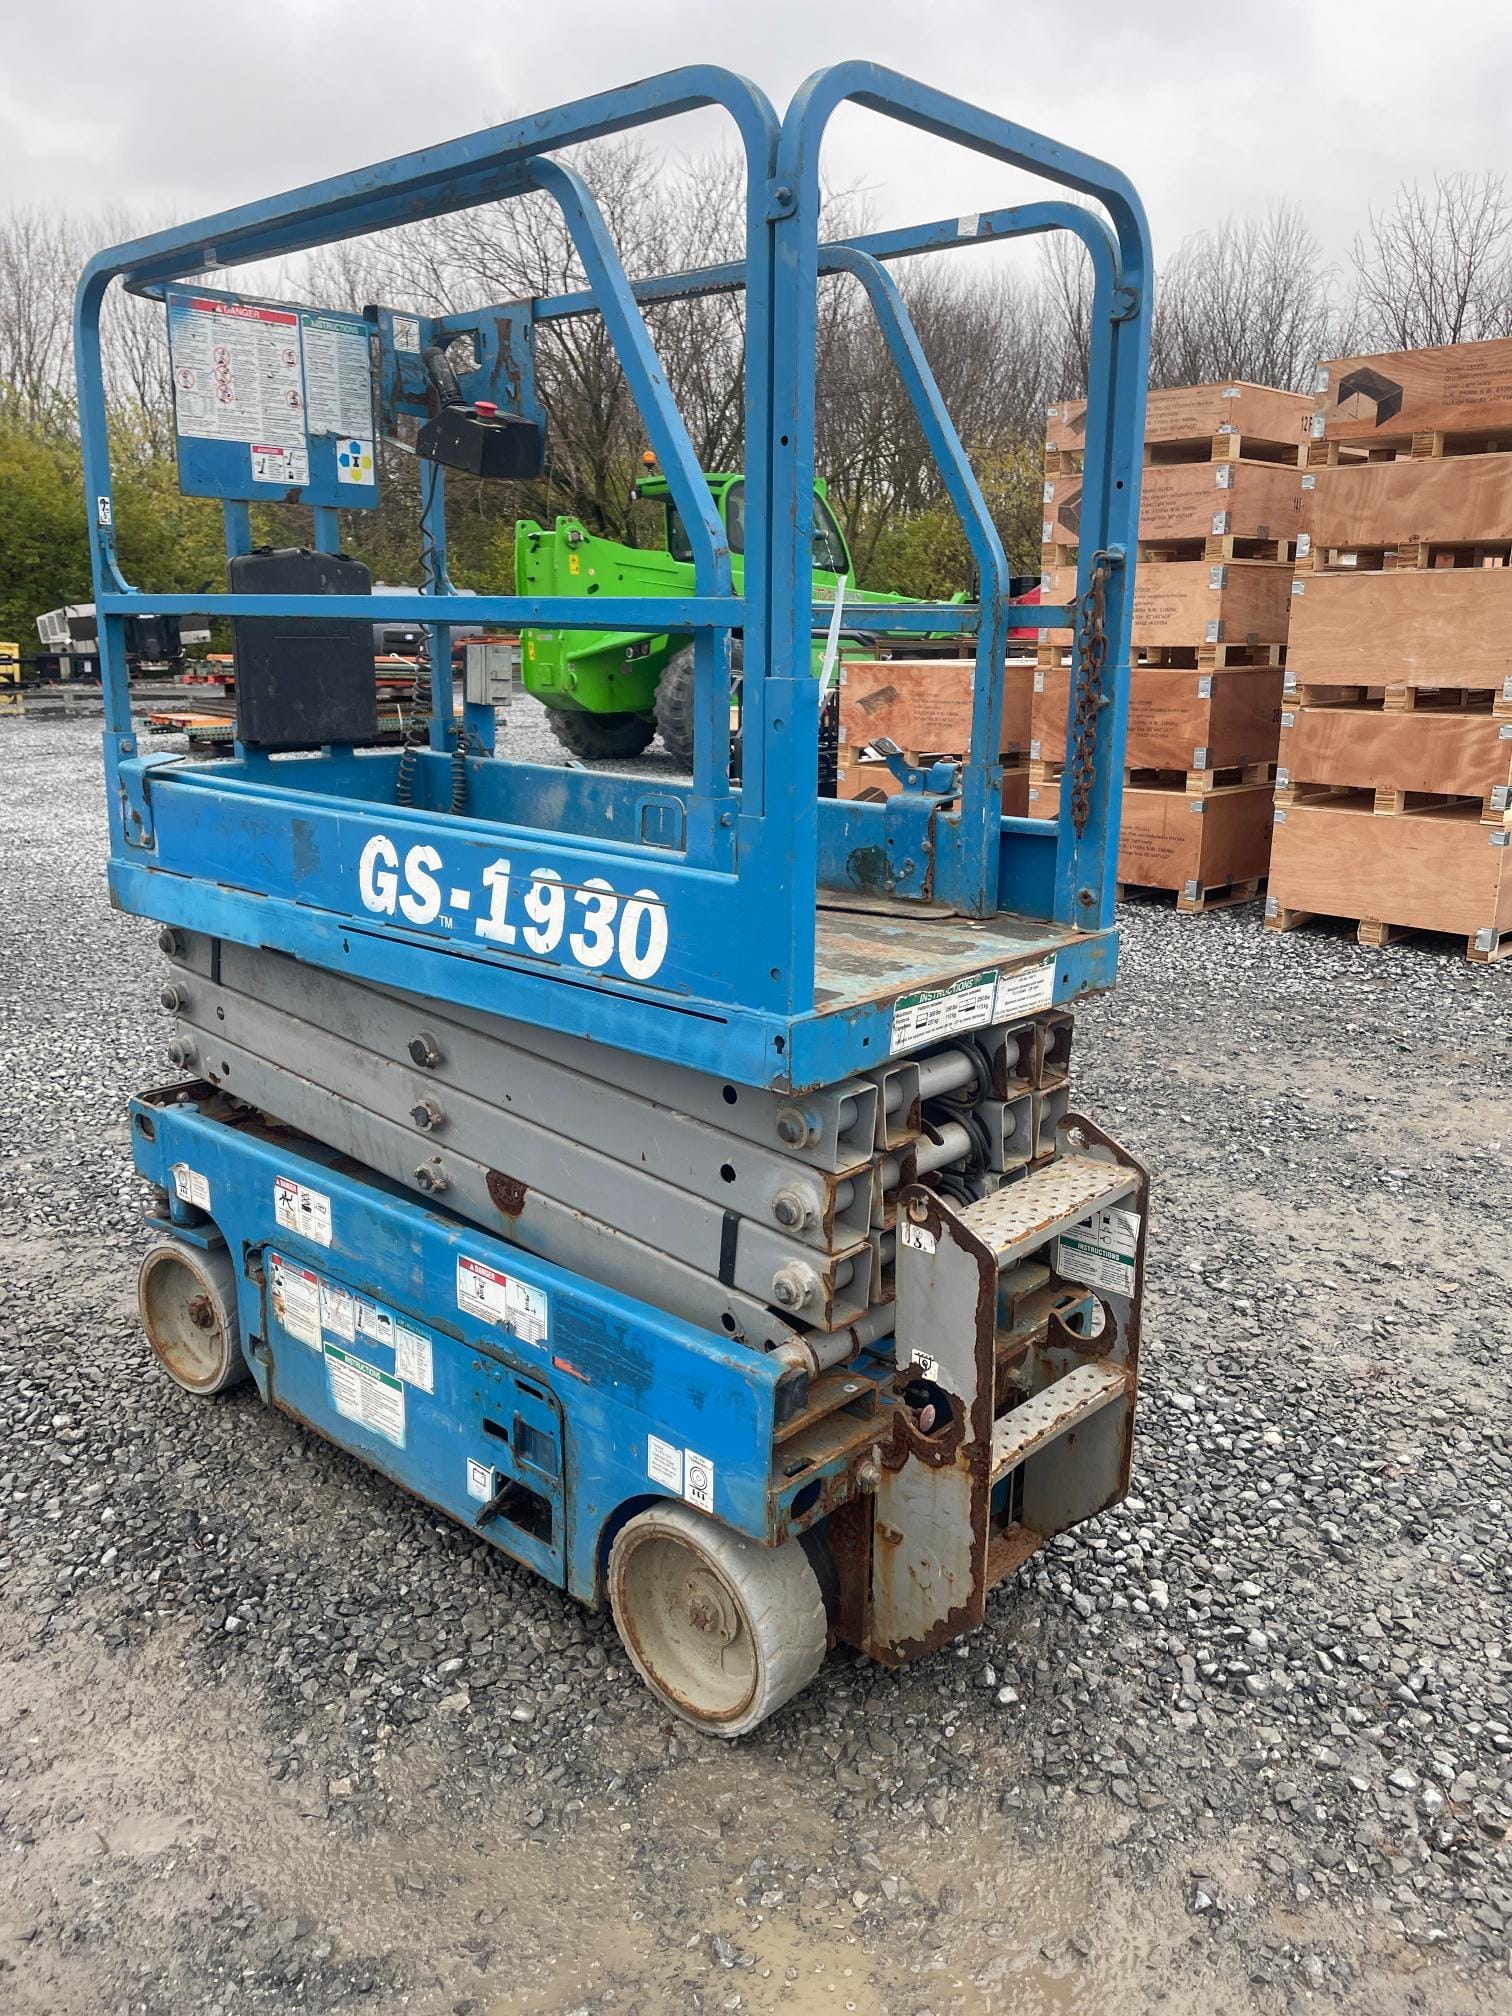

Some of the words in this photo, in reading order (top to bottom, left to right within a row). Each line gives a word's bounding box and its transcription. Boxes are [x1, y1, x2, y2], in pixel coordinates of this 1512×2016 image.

[359, 834, 668, 980] GS-1930
[439, 915, 453, 929] TM
[919, 977, 974, 1003] INSTRUCTIONS
[1077, 1243, 1120, 1261] INSTRUCTIONS
[474, 1264, 495, 1281] DANGER
[344, 1355, 381, 1380] INSTRUCTIONS
